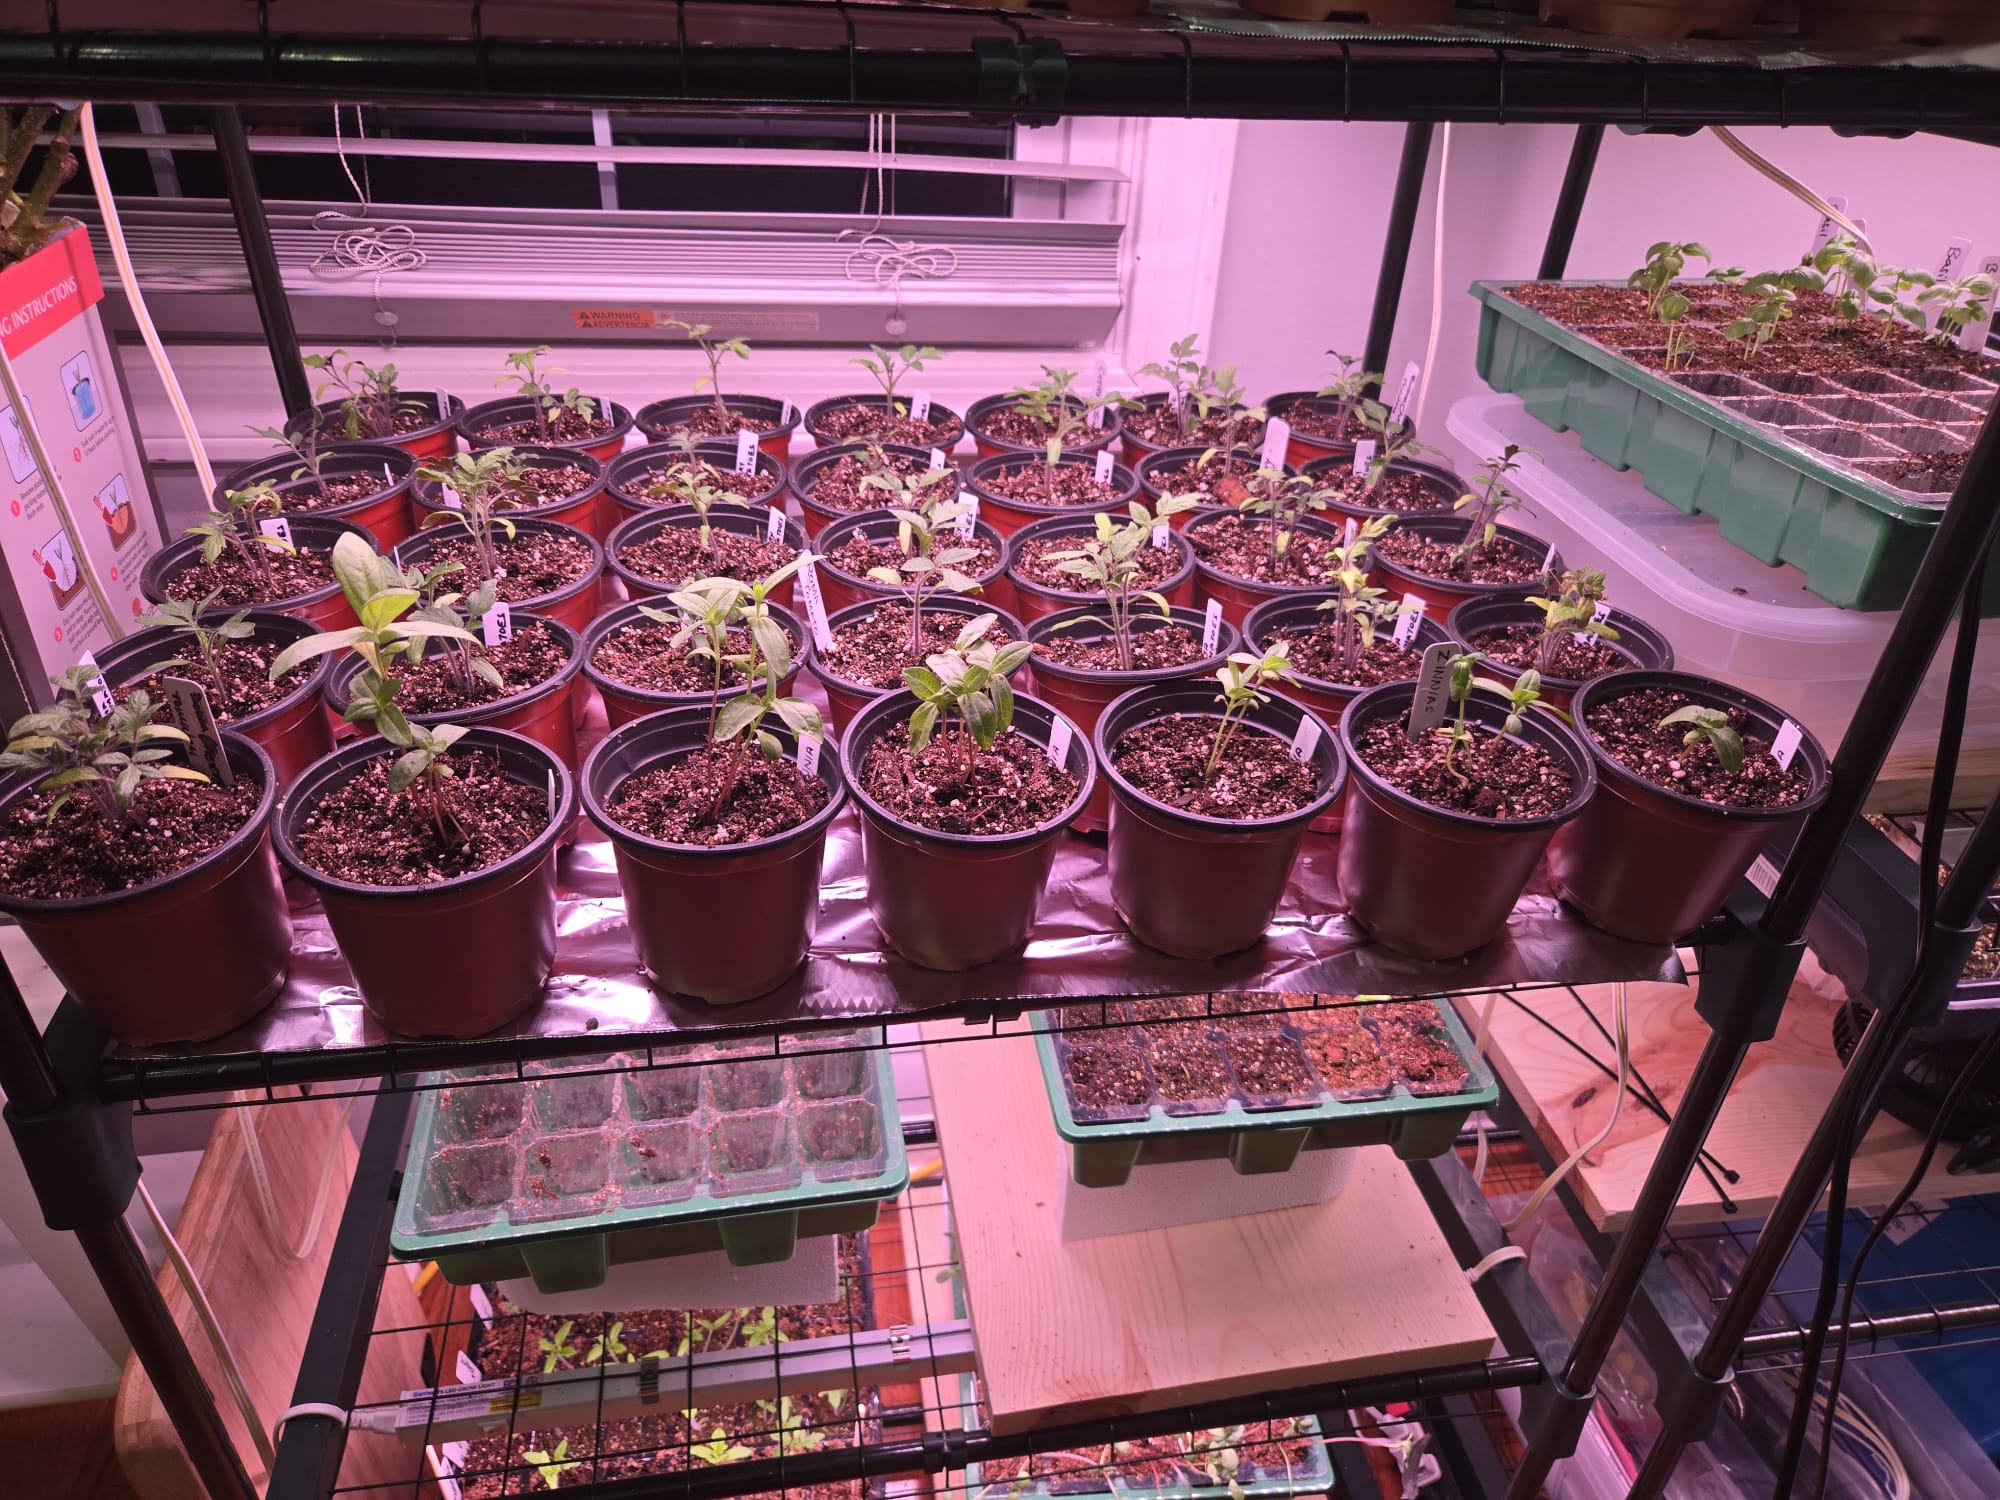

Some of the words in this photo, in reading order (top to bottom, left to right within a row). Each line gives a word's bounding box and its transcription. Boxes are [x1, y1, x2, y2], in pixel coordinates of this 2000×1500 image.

[1936, 247, 1962, 282] Basil
[11, 275, 77, 330] INSTRUCTIONS
[589, 312, 641, 320] WARNING
[592, 320, 650, 329] ADVERTENCIA
[1425, 649, 1450, 713] ZINNIAS
